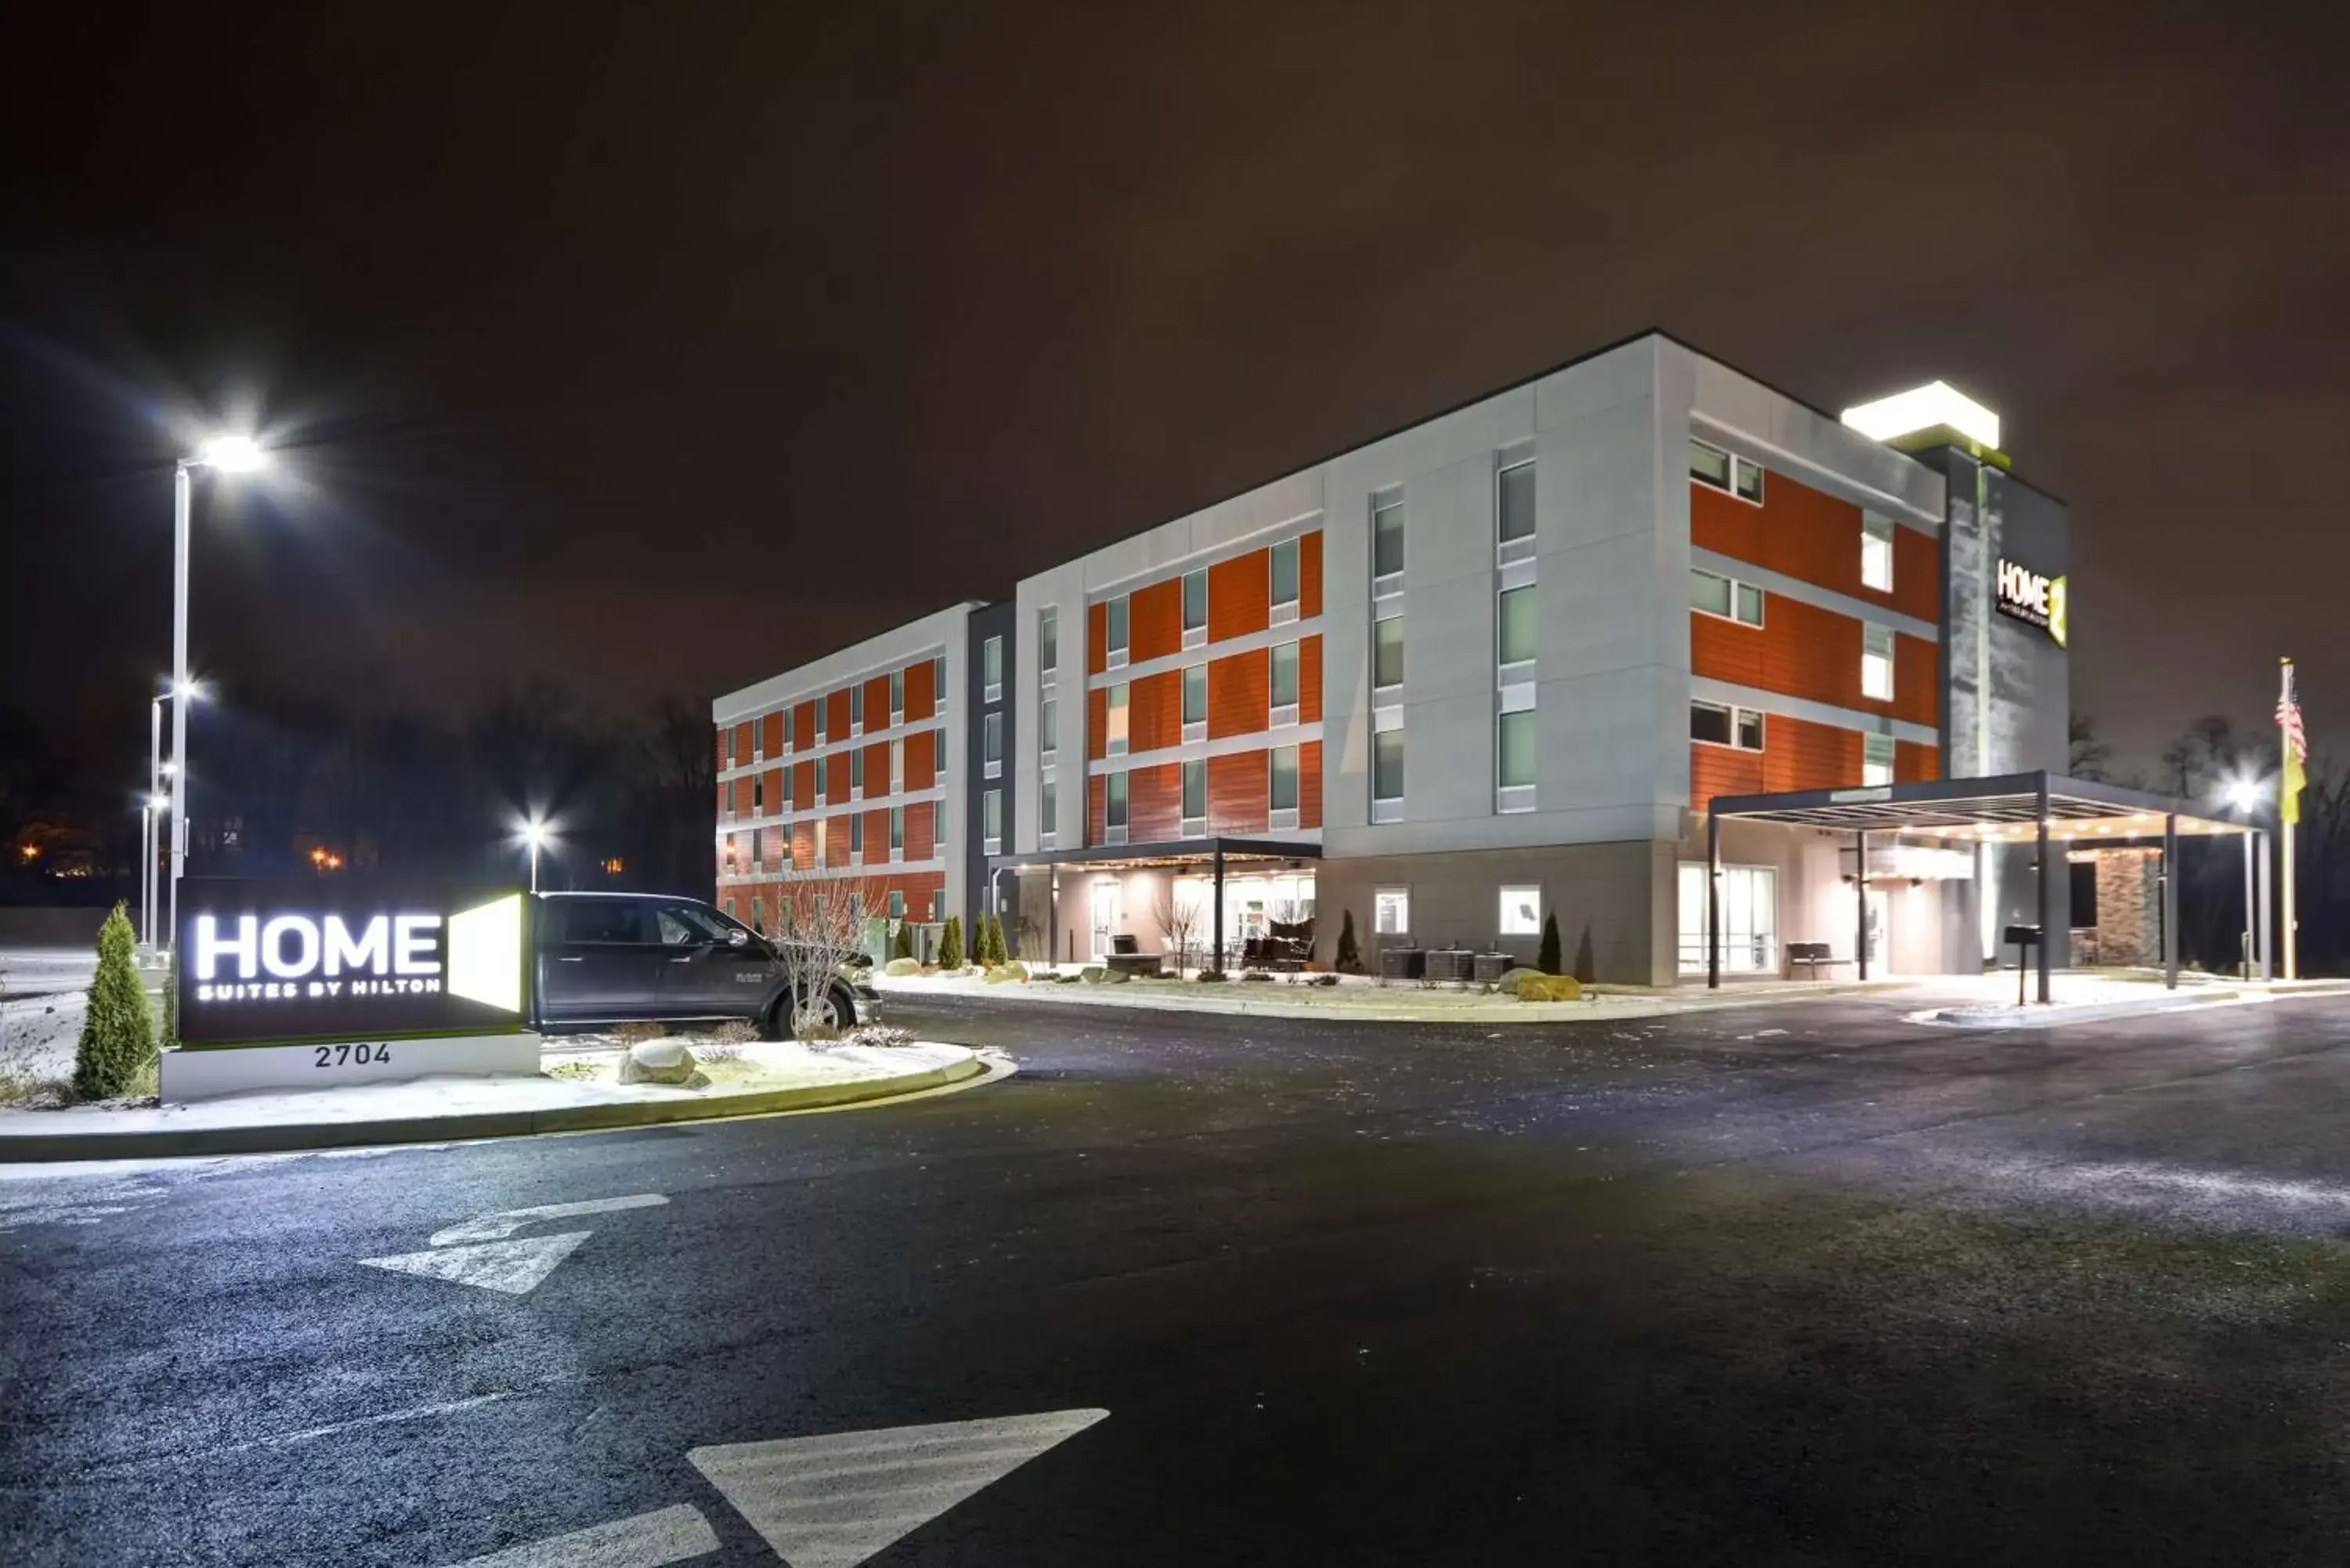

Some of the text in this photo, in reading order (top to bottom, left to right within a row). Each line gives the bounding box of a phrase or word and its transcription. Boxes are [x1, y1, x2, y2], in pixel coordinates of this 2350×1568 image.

[196, 914, 441, 981] HOME
[197, 978, 440, 1000] SUITES BY HILTON
[315, 1043, 390, 1068] 2704
